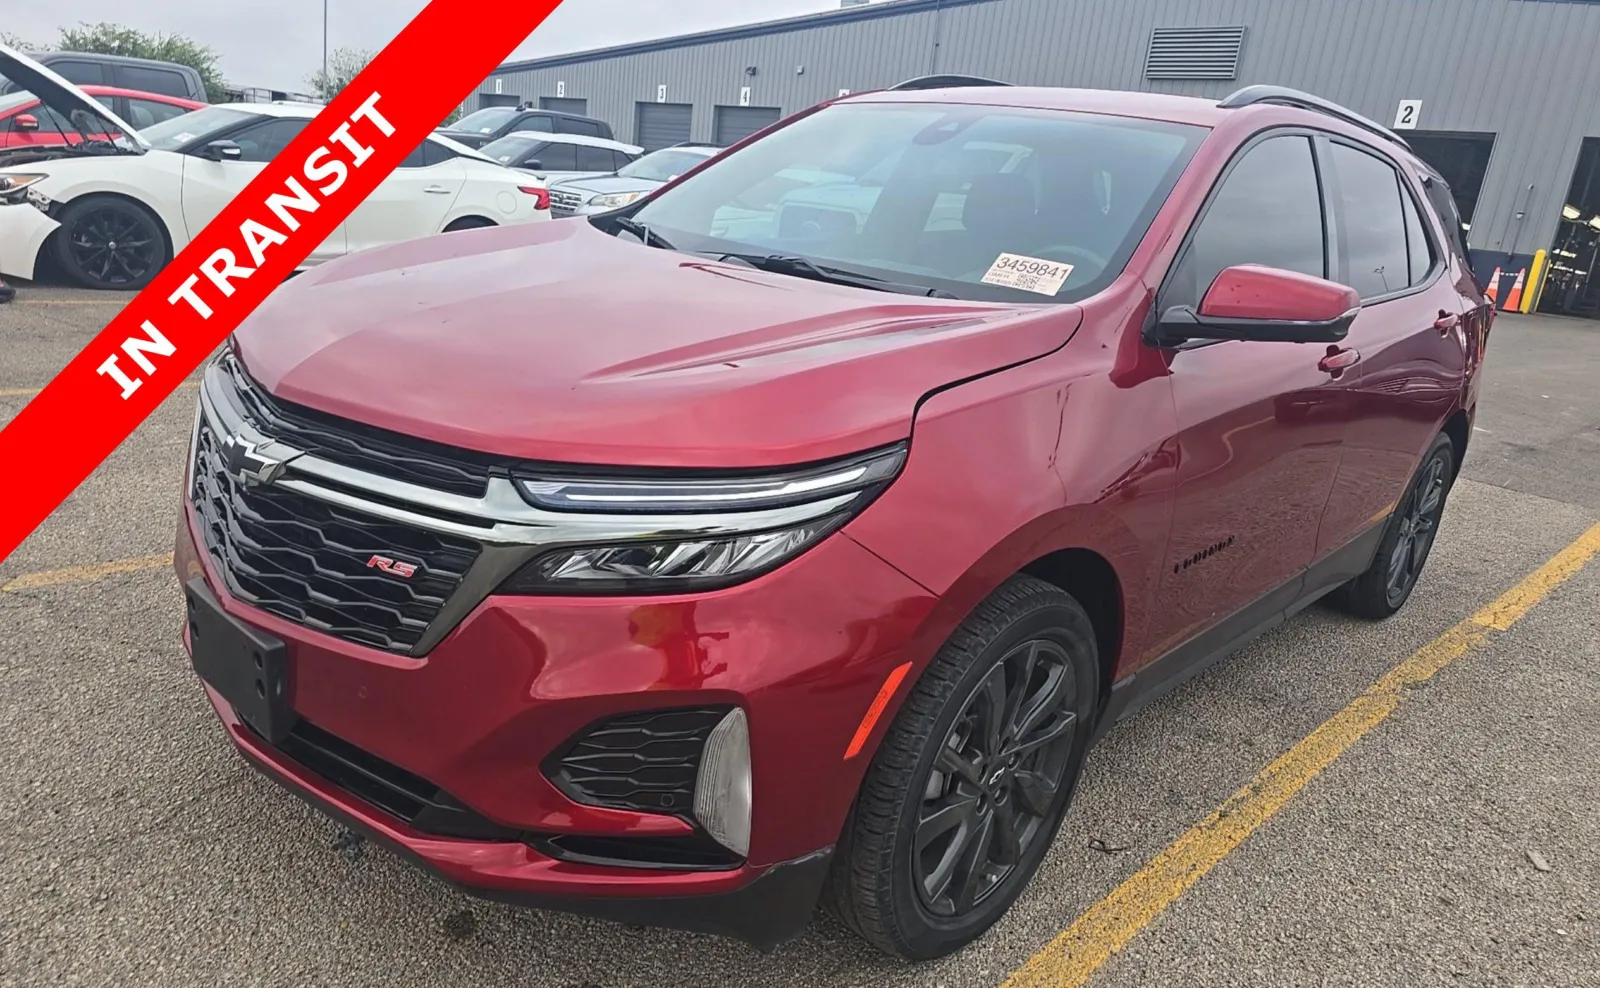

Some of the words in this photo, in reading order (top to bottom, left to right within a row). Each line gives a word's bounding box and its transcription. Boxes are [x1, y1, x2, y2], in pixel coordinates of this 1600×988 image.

[1401, 105, 1414, 124] 2
[996, 257, 1069, 280] 3459841
[366, 555, 418, 578] RS
